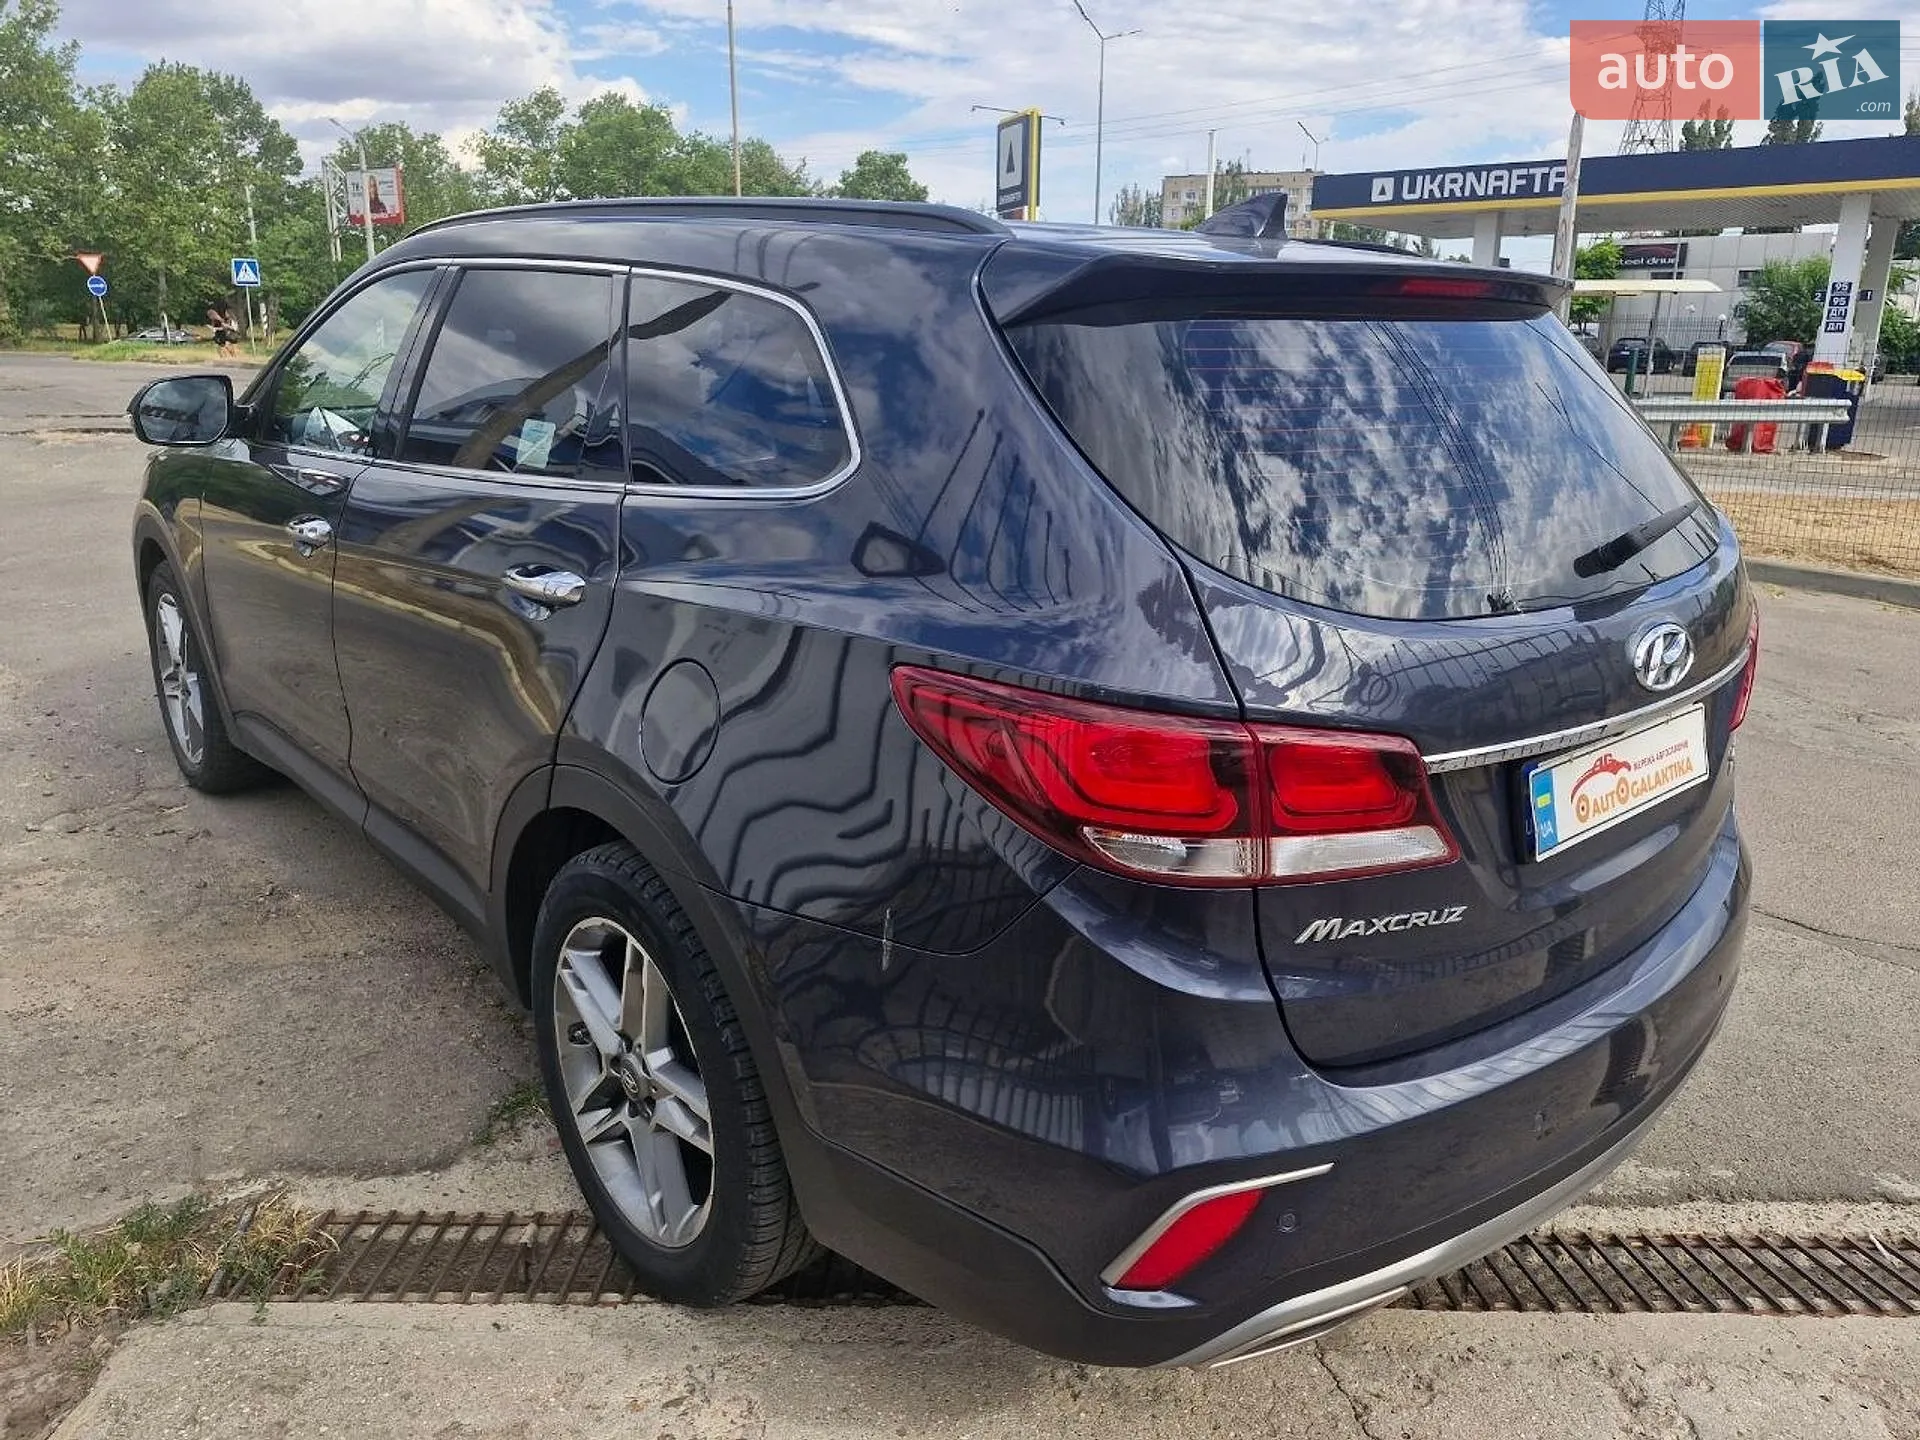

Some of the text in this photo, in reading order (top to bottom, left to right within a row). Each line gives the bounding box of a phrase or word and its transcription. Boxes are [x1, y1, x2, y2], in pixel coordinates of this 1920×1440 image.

[1402, 166, 1567, 200] UKRNAFTA
[1832, 296, 1847, 306] 95
[1294, 905, 1468, 945] MAXCRUZ
